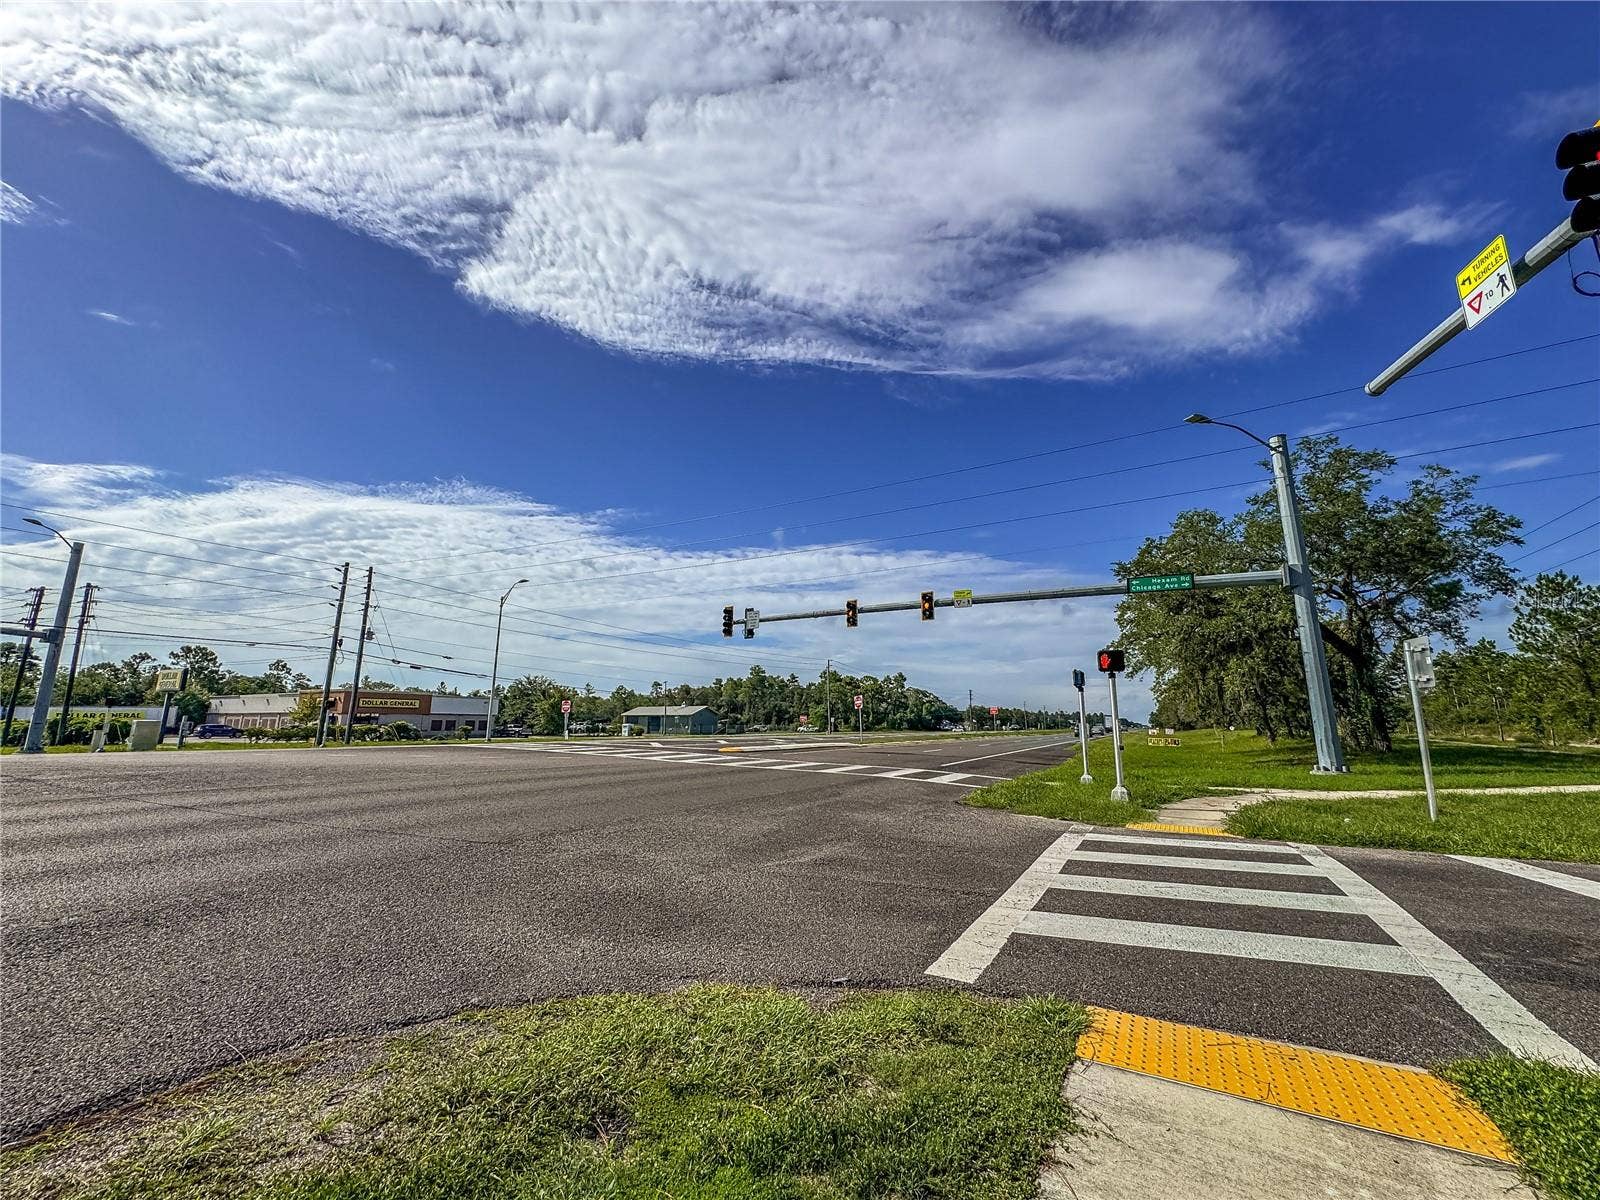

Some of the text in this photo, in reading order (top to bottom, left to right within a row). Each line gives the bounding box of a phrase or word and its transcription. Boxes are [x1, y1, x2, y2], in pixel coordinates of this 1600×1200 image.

[1472, 243, 1501, 273] TURNING
[1473, 252, 1504, 283] VEHICLES
[1485, 289, 1494, 300] TO
